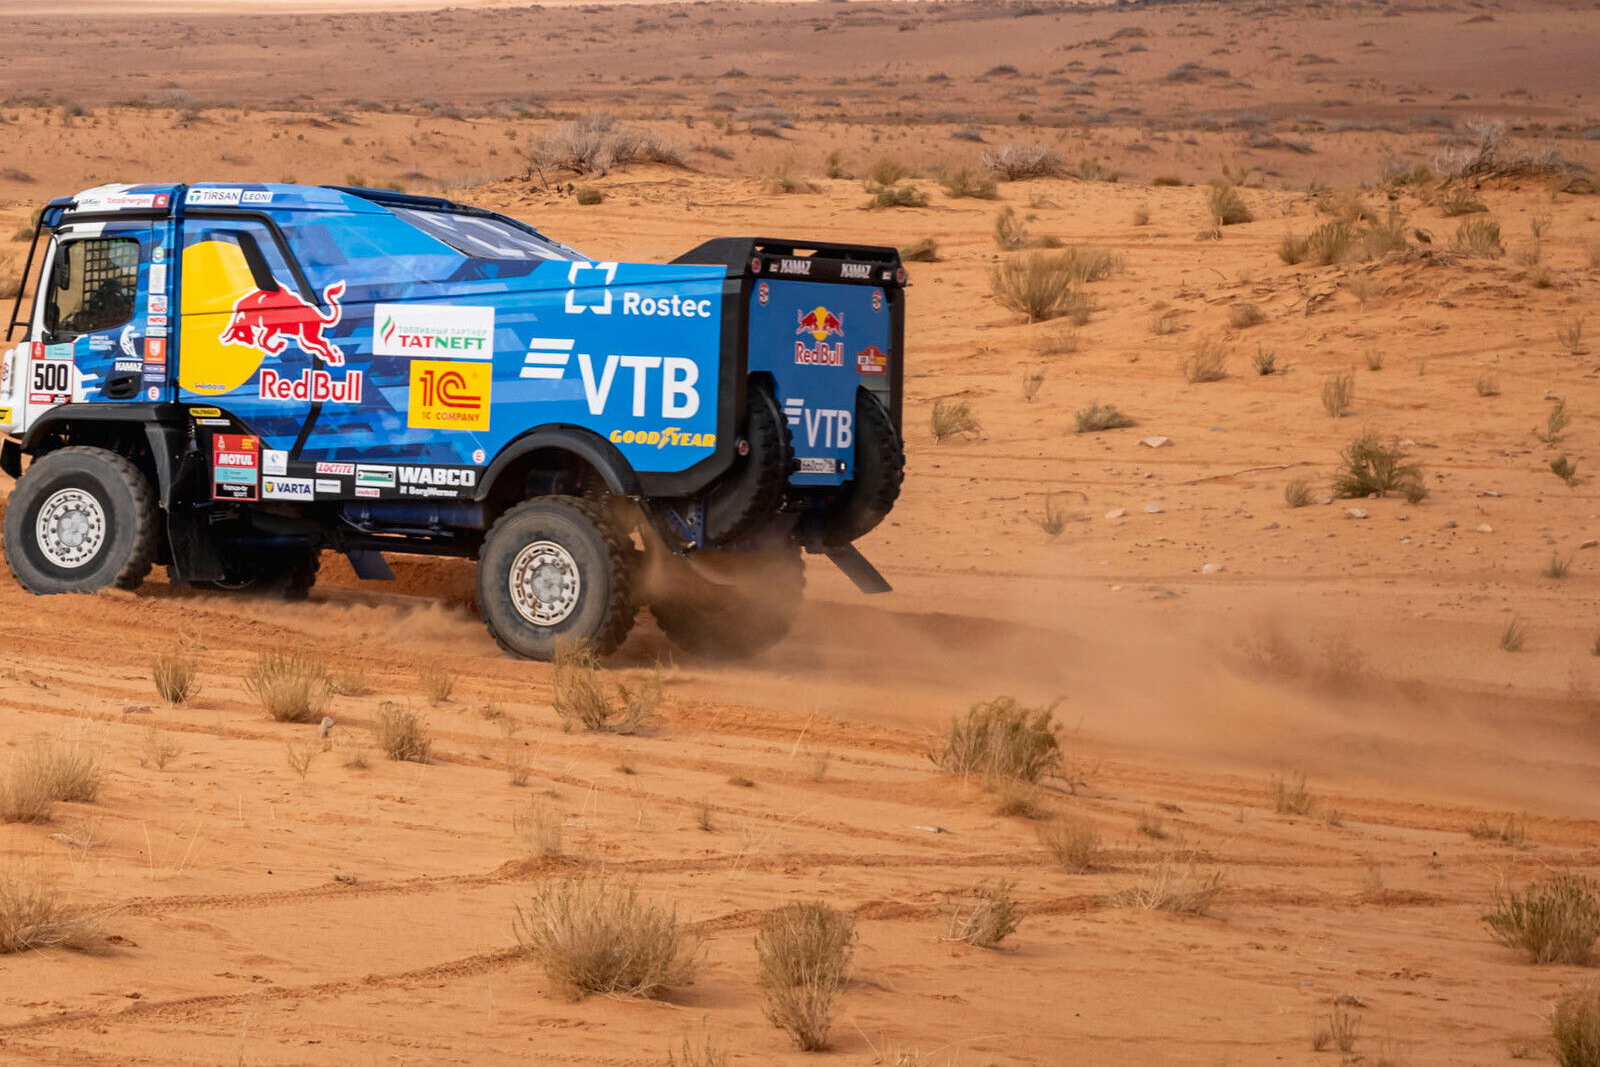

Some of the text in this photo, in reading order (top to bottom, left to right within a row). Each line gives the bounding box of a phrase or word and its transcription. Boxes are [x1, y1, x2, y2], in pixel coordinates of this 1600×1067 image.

[243, 193, 271, 201] LEONI
[780, 258, 812, 275] KAMAZ
[840, 262, 872, 279] KAMAZ
[623, 292, 712, 318] Rostec
[398, 334, 486, 350] TATNEFT
[795, 341, 844, 366] Red Bull
[115, 361, 143, 373] KAMAZ
[34, 363, 69, 391] 500
[260, 369, 361, 402] Red Bull
[577, 353, 700, 419] VTB
[435, 412, 480, 422] COMPANY
[804, 408, 852, 449] VTB
[609, 428, 716, 449] GOODYEAR
[218, 453, 254, 466] MOTUL
[318, 462, 354, 474] LOCTITE
[398, 466, 476, 487] WABCO
[277, 482, 312, 495] VARTA
[409, 486, 459, 498] BorgWarner
